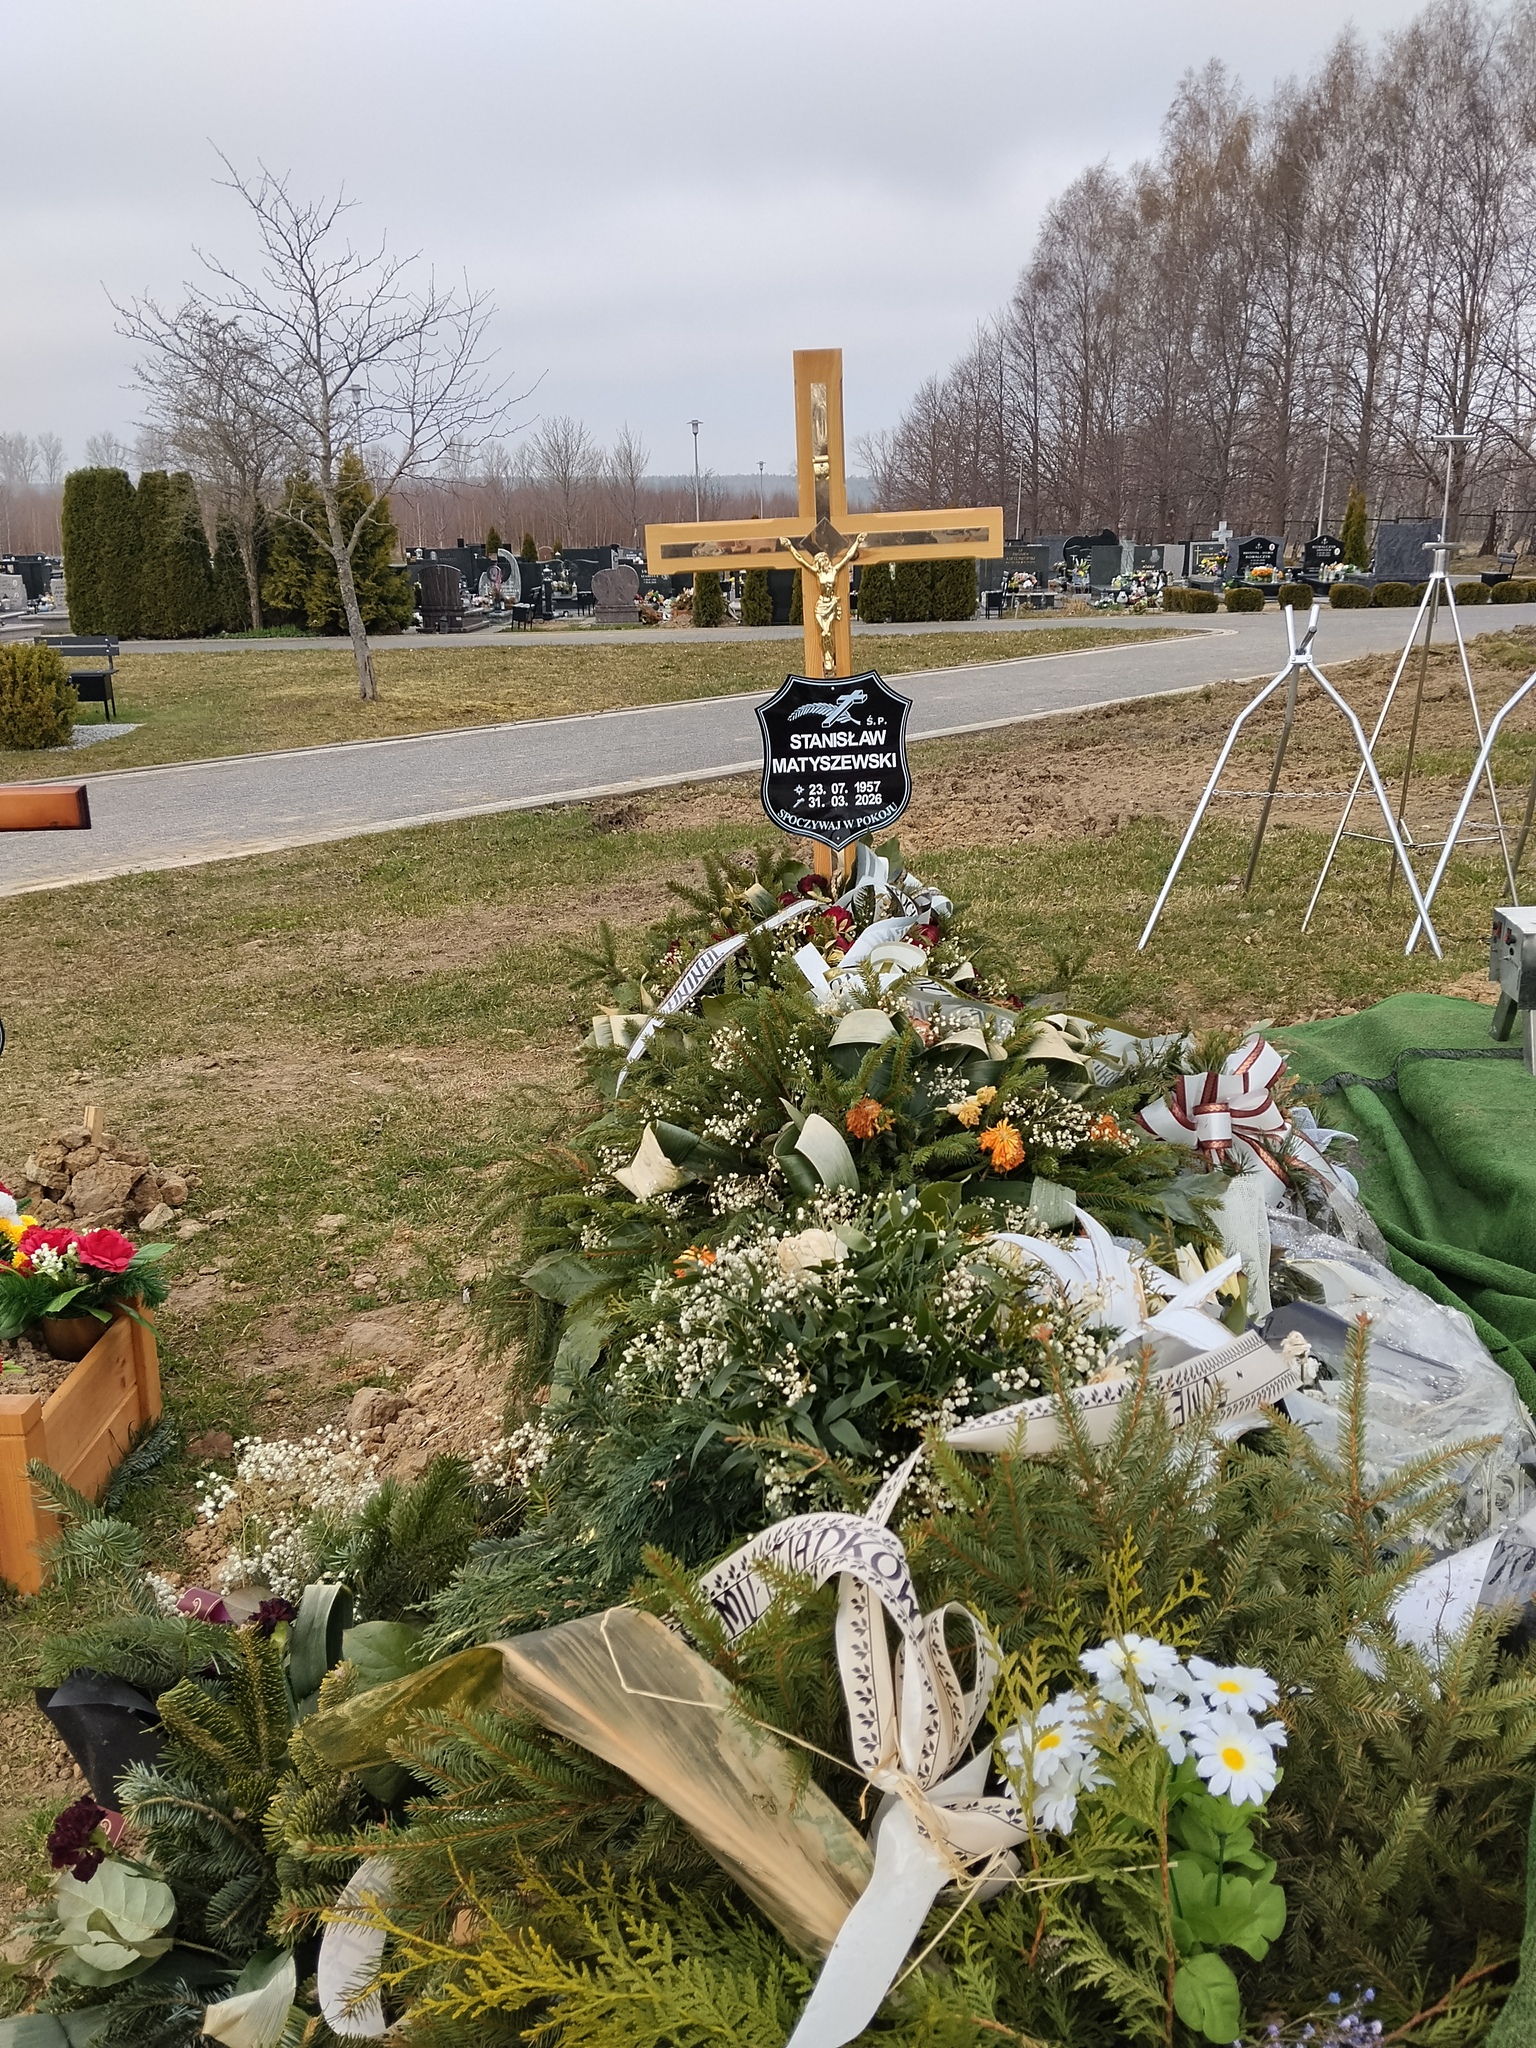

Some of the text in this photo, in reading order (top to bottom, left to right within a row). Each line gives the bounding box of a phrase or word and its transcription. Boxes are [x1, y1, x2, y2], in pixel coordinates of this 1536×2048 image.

[789, 730, 887, 750] STANISŁAW
[772, 753, 897, 774] MATYSZEWSKI
[808, 781, 881, 796] 23. 07. 1957
[808, 794, 883, 808] 31. 03. 2026
[777, 802, 899, 831] SPOCZYWAJ W POKOJU
